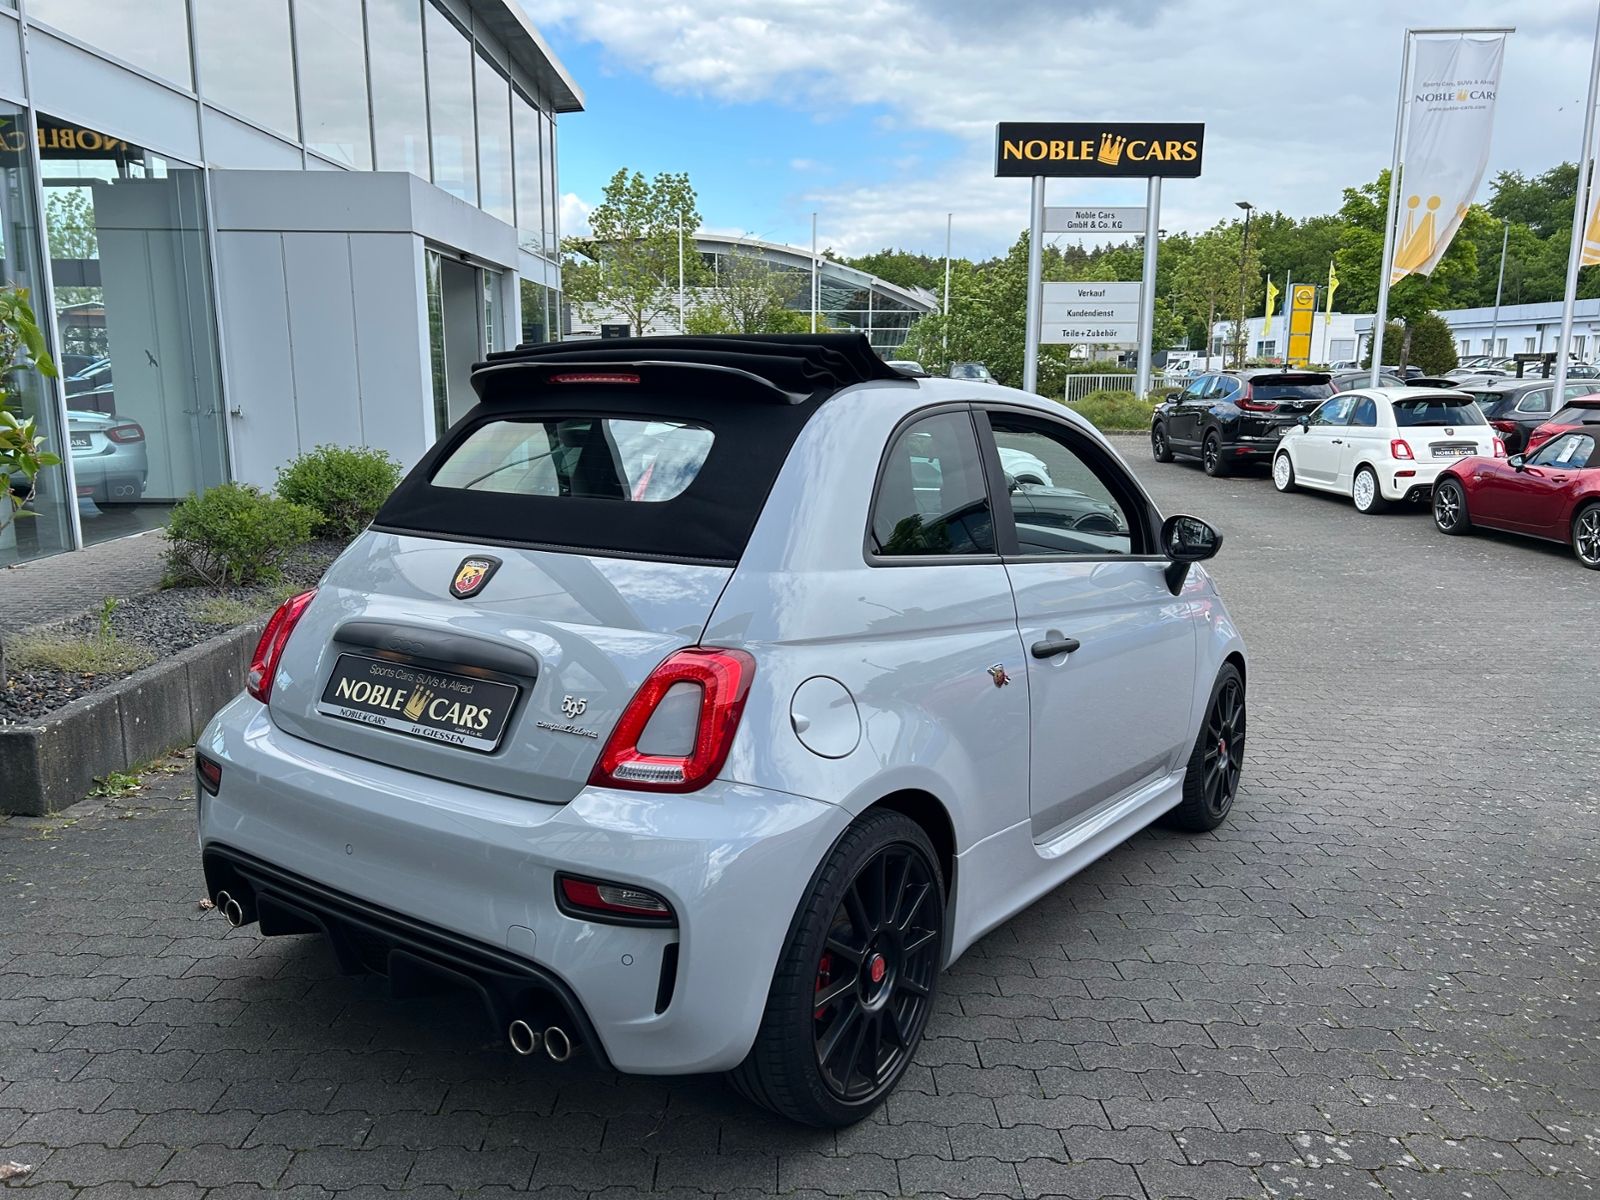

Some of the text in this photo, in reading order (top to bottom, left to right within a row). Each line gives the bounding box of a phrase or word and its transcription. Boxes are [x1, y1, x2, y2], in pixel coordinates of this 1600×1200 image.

[1416, 93, 1454, 102] NOBLE
[1003, 140, 1197, 161] NOBLE CARS
[1075, 211, 1115, 219] Noble Cars
[1067, 221, 1123, 229] GmbH & Co. KG
[1078, 289, 1105, 297] Verkauf
[369, 664, 395, 677] Sports
[415, 674, 439, 687] SUVs
[440, 679, 447, 688] &
[448, 681, 474, 694] Allrad
[335, 677, 492, 730] NOBLE CARS
[561, 694, 587, 718] 595
[339, 708, 388, 726] NOBLE CARS
[411, 725, 466, 744] in GIESSEN
